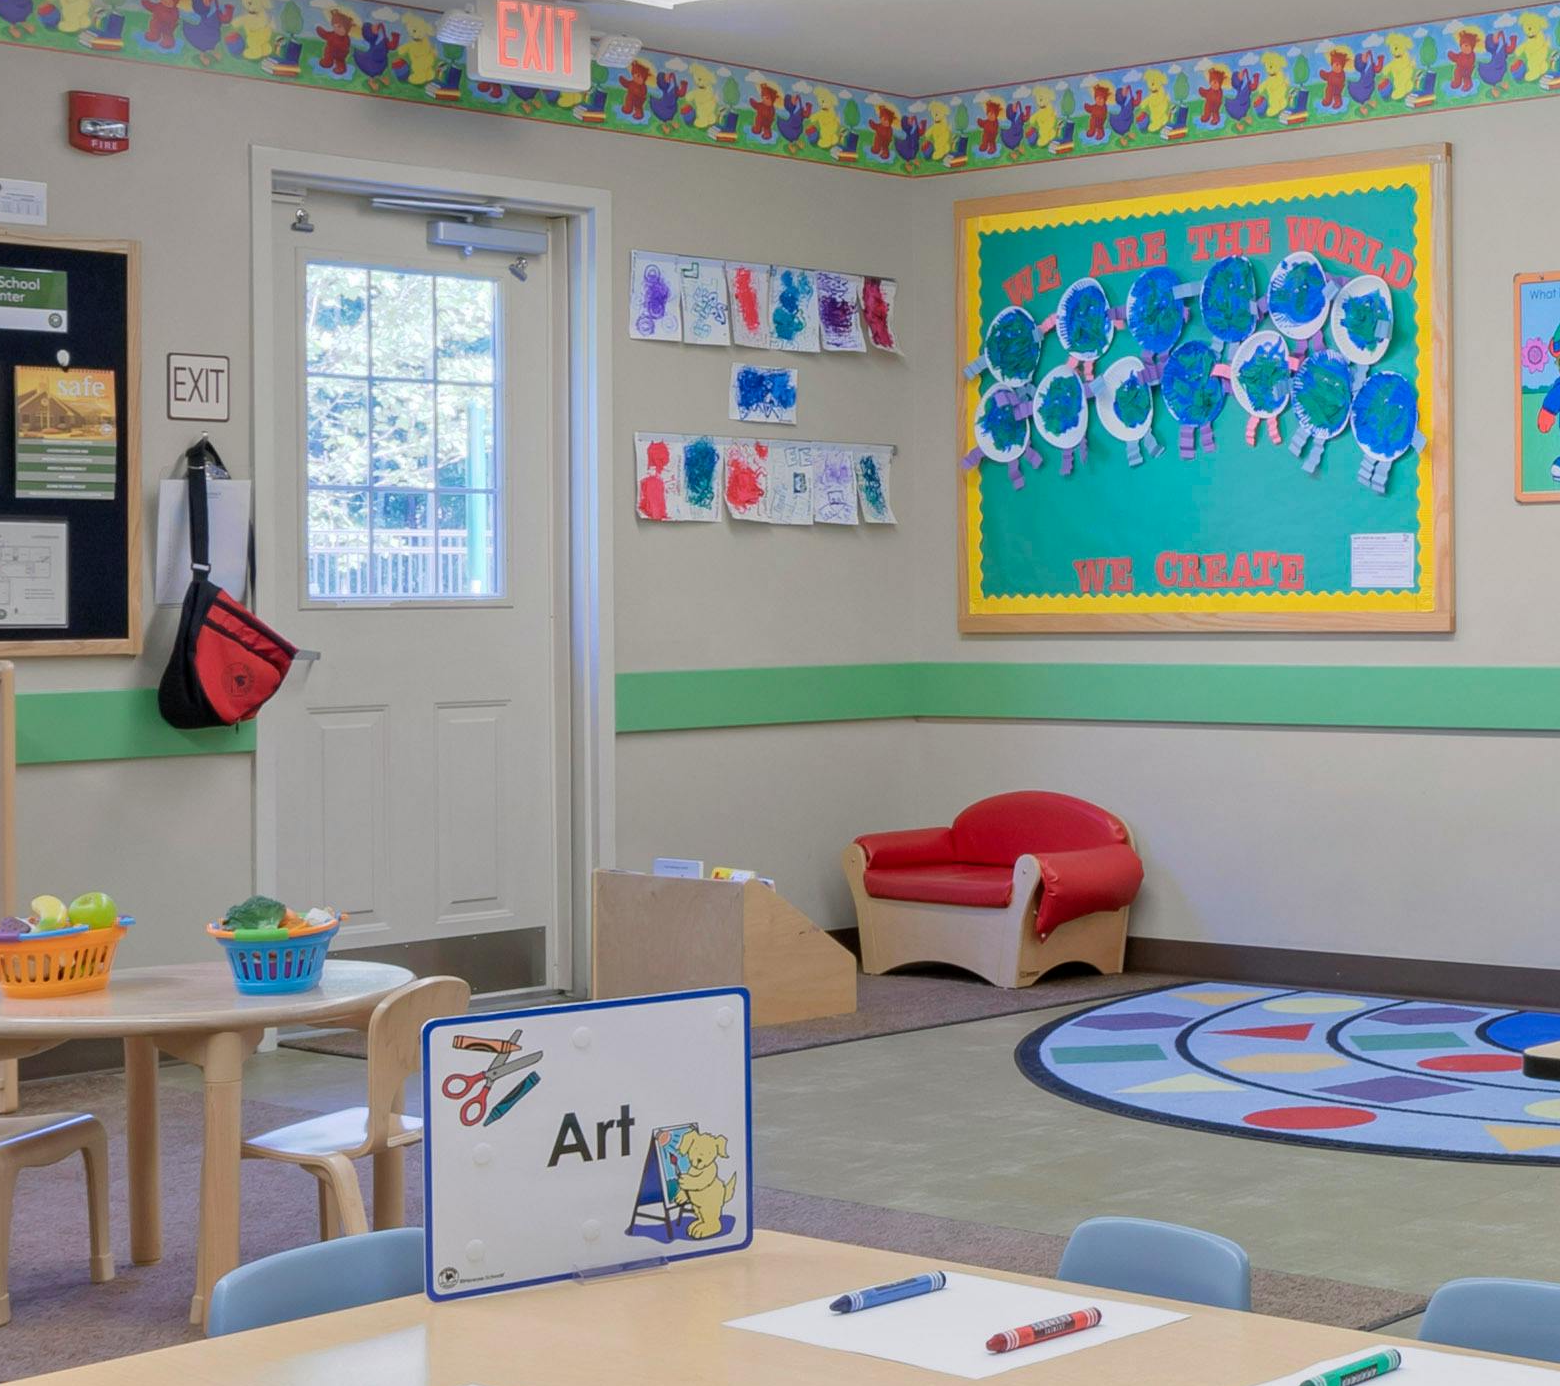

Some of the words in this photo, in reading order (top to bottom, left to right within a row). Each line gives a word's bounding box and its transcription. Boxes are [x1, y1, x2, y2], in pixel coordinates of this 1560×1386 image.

[91, 140, 117, 150] FIRE
[1002, 254, 1062, 307] WE
[1088, 229, 1168, 278] ARE
[1186, 219, 1272, 261] THE
[1286, 216, 1416, 290] WORLD
[1530, 289, 1556, 300] What
[57, 375, 105, 397] safe
[174, 366, 225, 404] EXIT
[1073, 558, 1134, 593] WE
[1155, 550, 1305, 591] CREATE
[547, 1104, 635, 1167] Art
